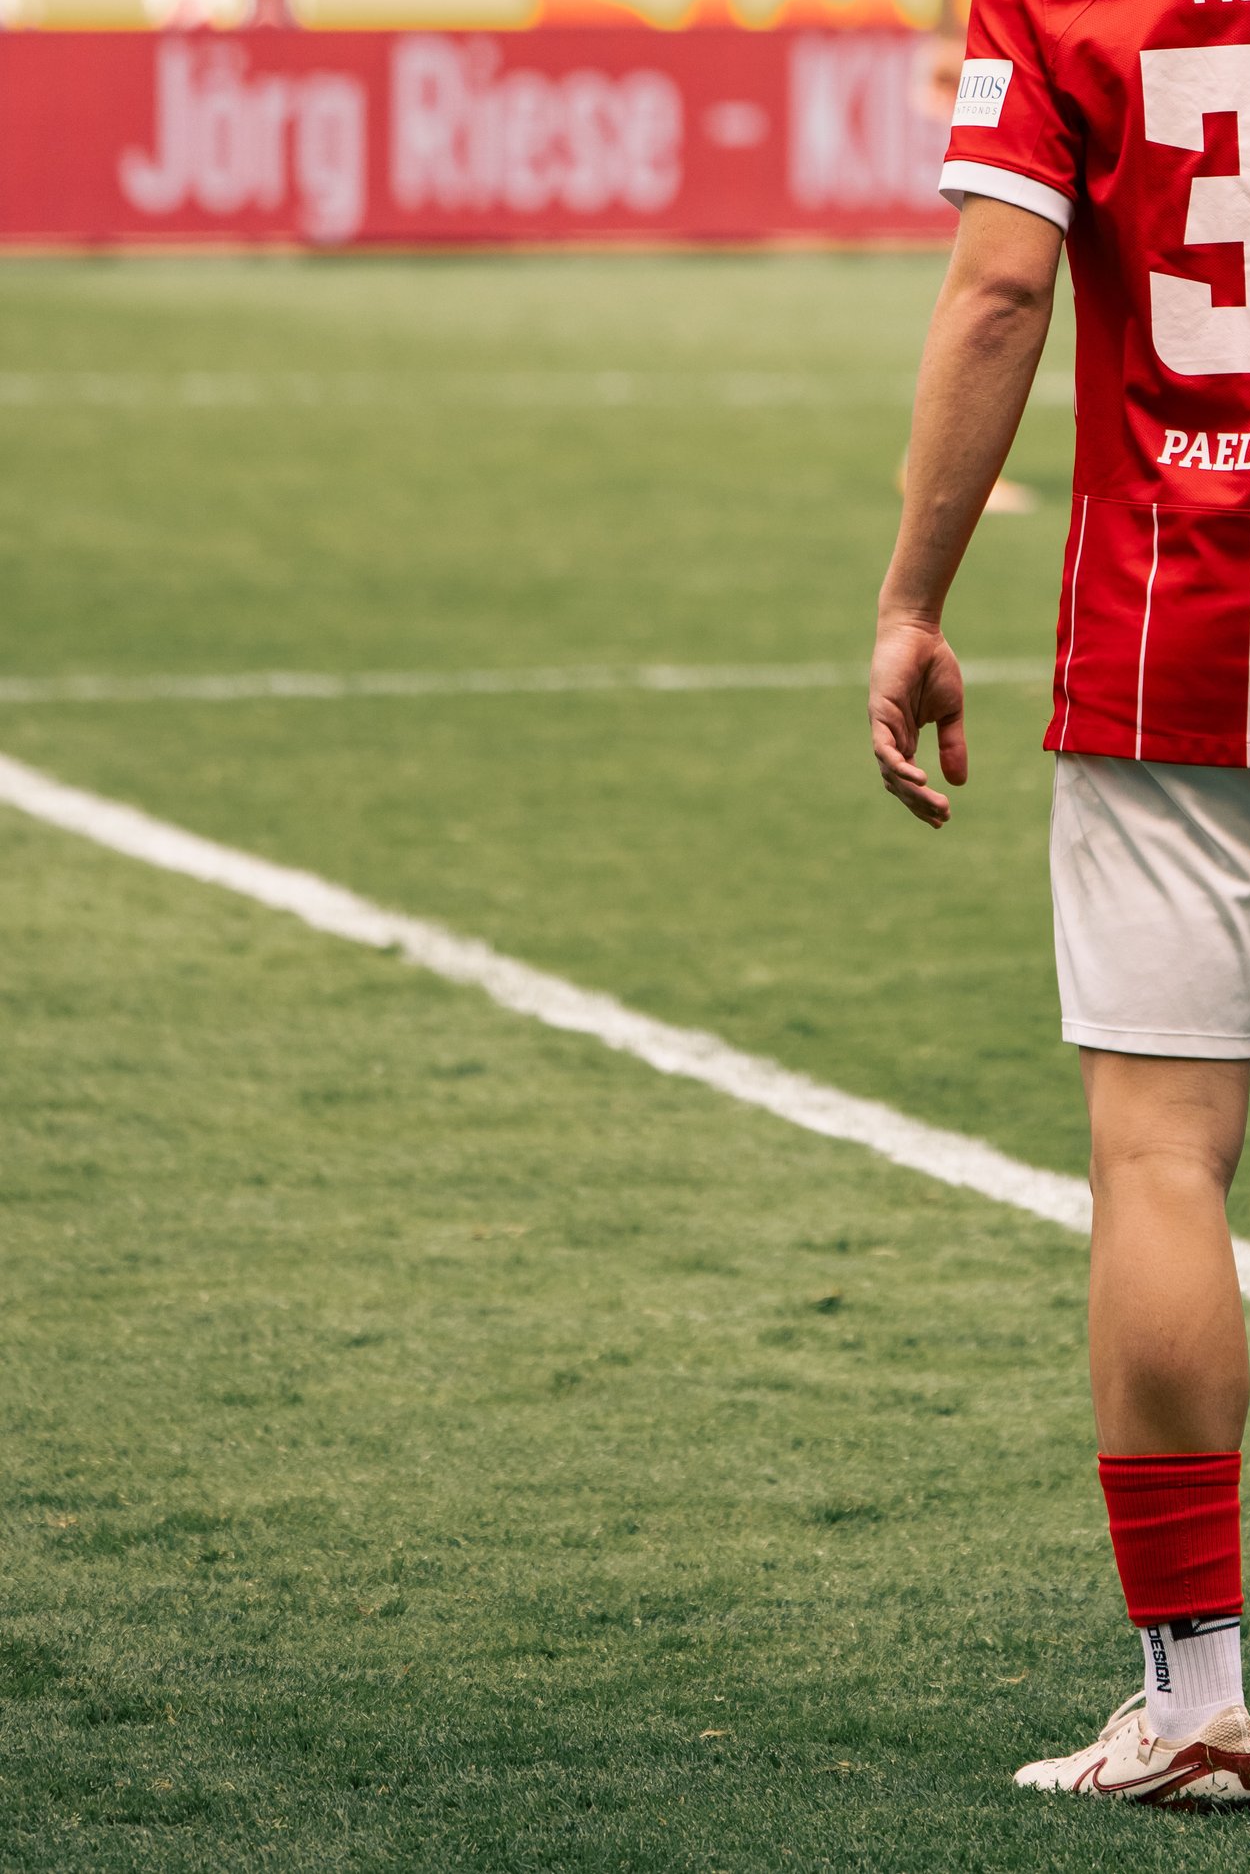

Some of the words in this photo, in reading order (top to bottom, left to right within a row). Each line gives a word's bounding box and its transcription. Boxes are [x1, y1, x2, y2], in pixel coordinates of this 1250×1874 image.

[959, 75, 1006, 100] UTOS
[118, 34, 370, 246] Jörg
[389, 34, 684, 216] Riese
[1146, 1624, 1172, 1693] DESIGN
